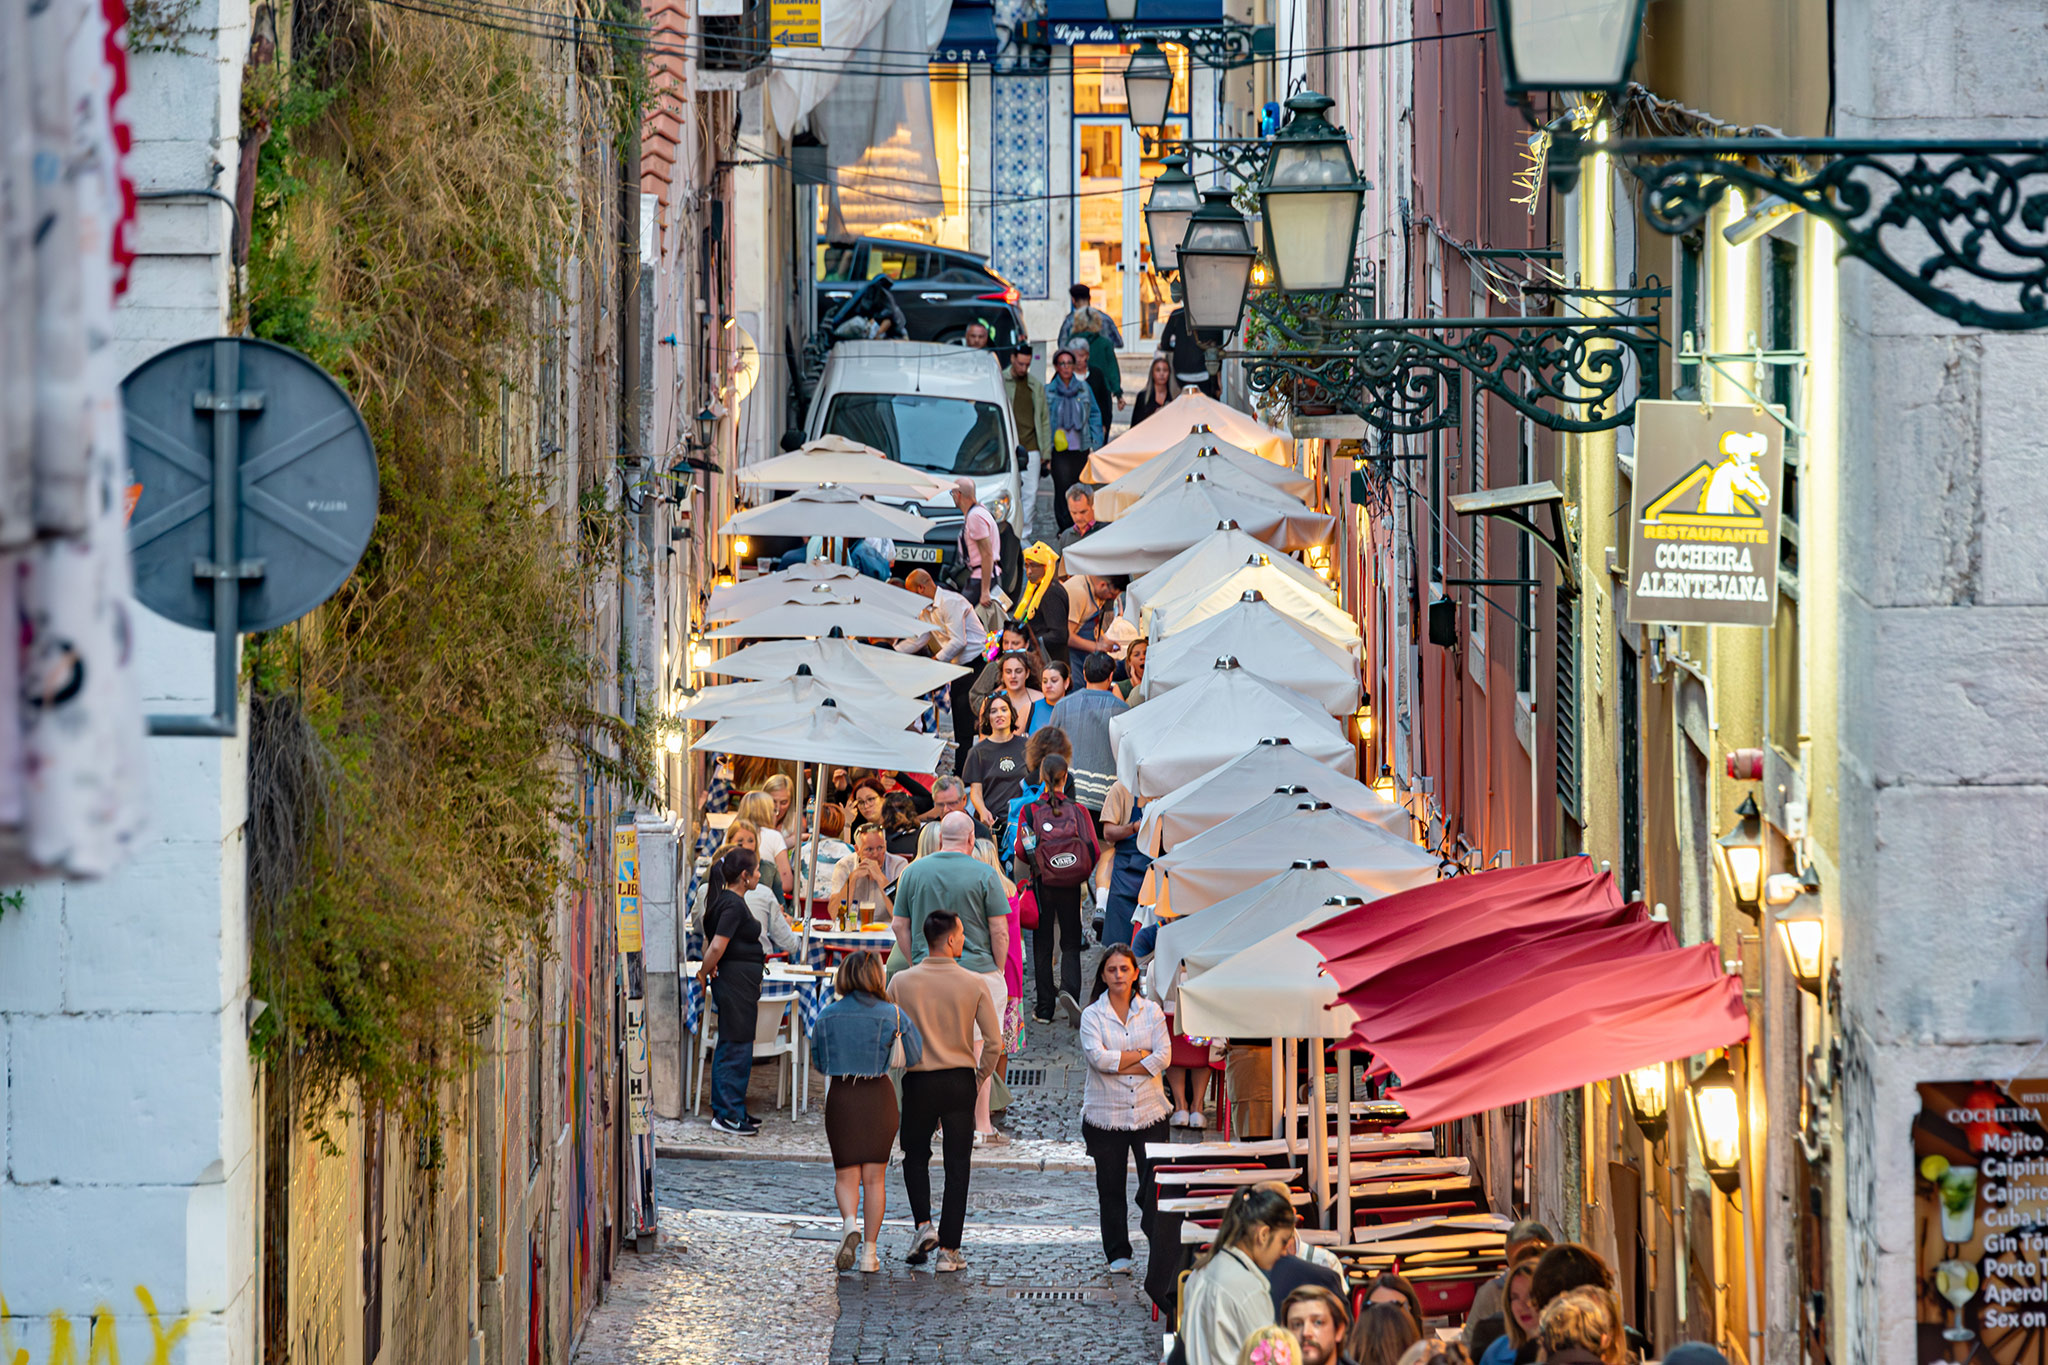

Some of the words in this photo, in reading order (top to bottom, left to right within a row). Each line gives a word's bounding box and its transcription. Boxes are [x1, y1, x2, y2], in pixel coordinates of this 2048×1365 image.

[1643, 525, 1769, 544] RESTAURANTE
[1655, 543, 1754, 573] COCHEIRA
[1636, 571, 1769, 602] ALENTEJANA
[1946, 1107, 2042, 1124] COCHEIRA
[1982, 1131, 2044, 1157] Mojito
[1983, 1207, 2031, 1228] Cuba
[1984, 1232, 2018, 1253] Gin
[1984, 1258, 2036, 1278] Porto
[1985, 1282, 2048, 1307] Aperol
[1985, 1308, 2019, 1329] Sex
[2022, 1311, 2046, 1328] on
